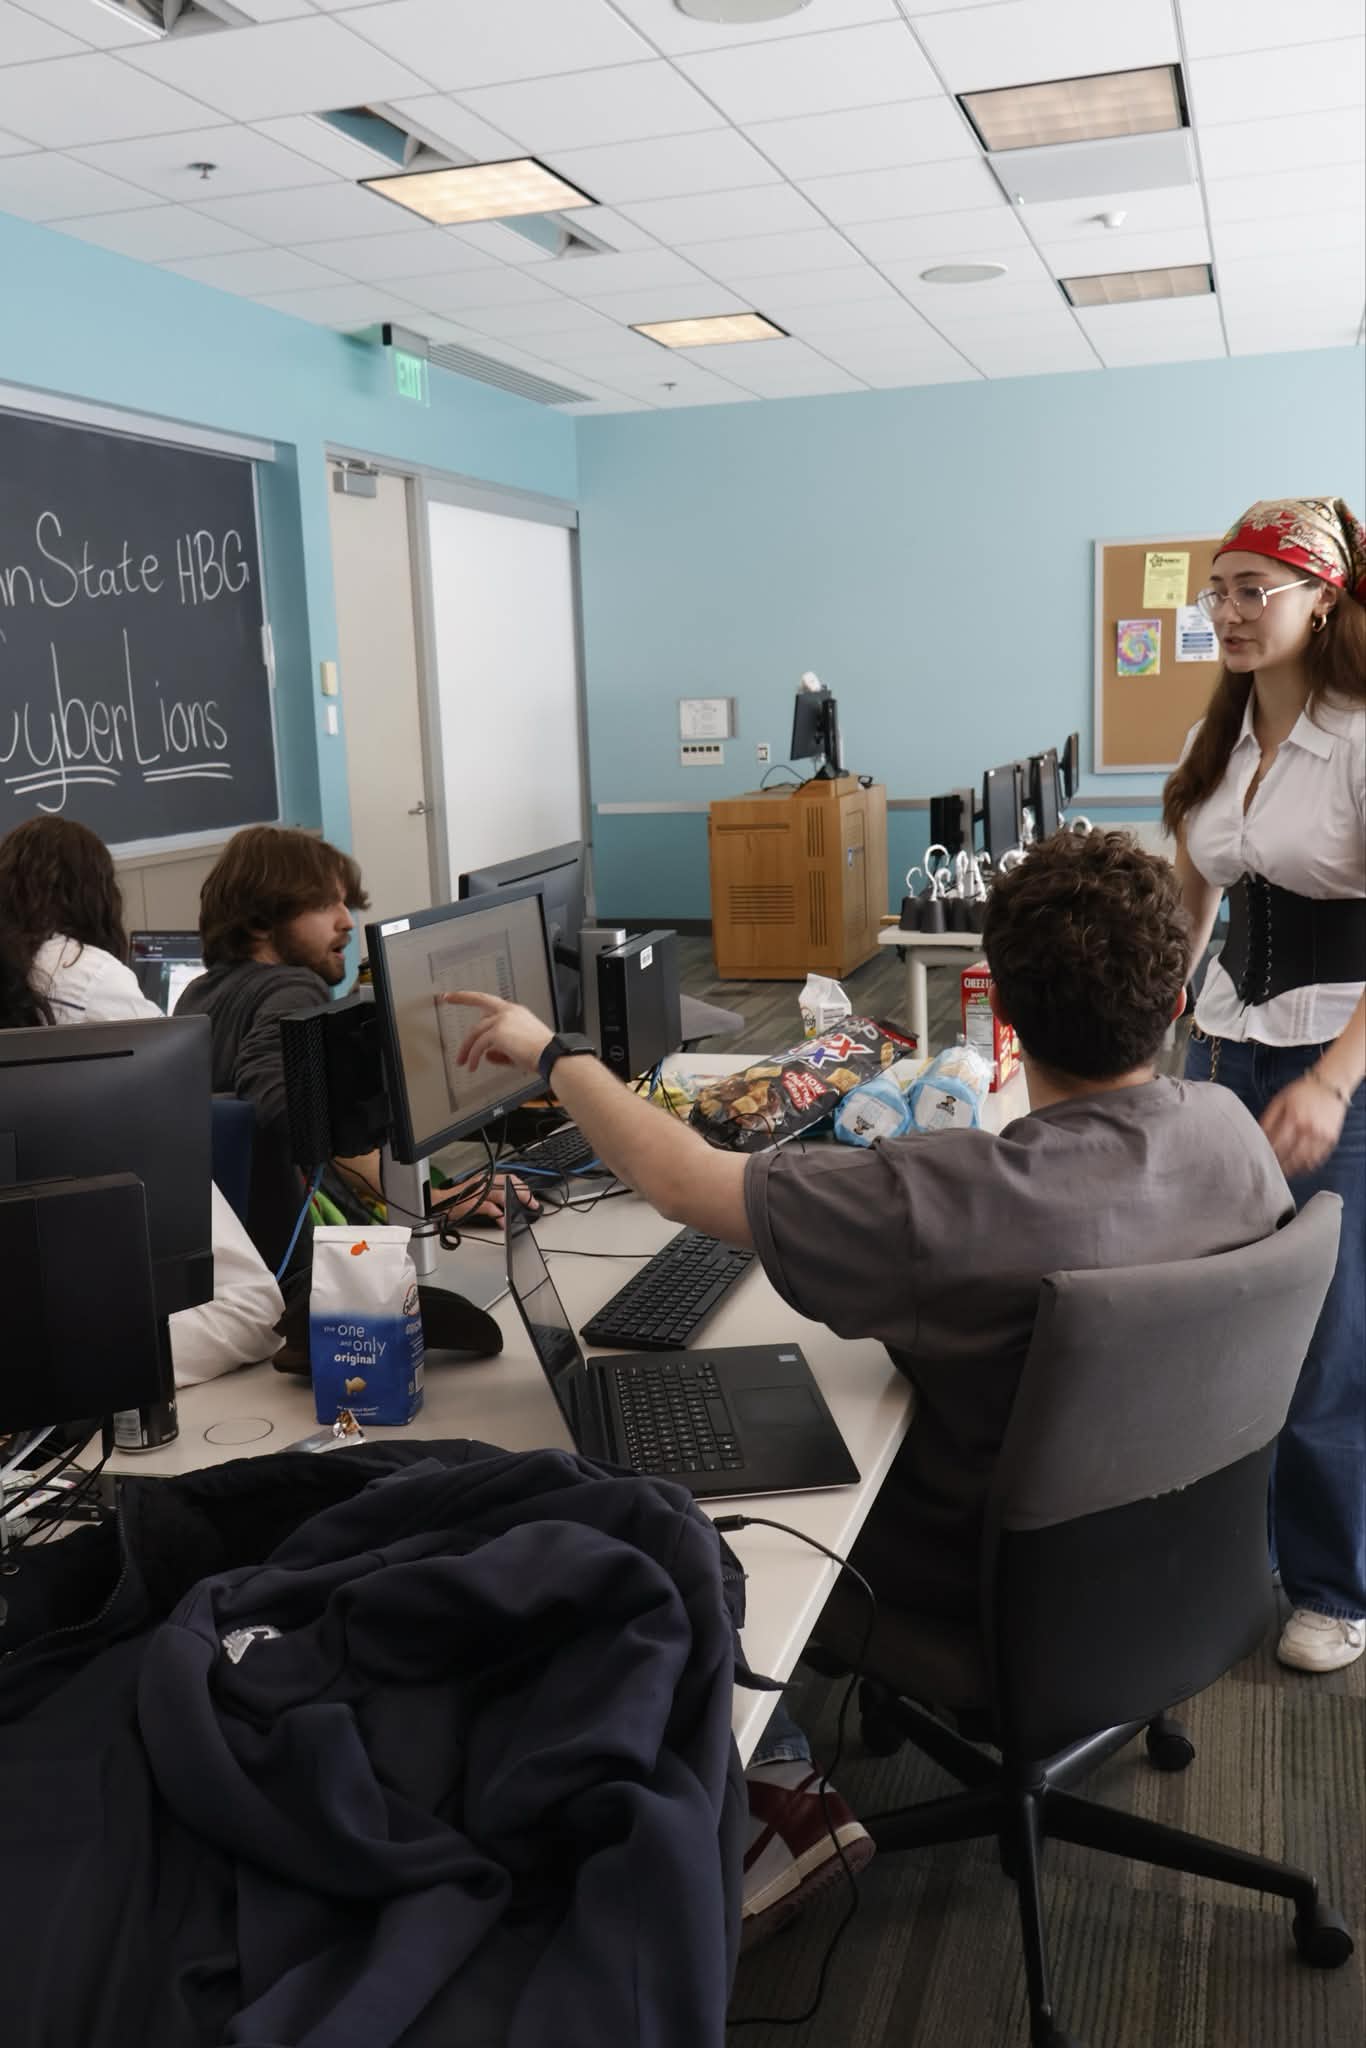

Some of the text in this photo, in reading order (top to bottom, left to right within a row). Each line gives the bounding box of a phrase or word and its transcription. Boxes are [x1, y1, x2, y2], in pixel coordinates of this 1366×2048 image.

[177, 529, 250, 605] HBG
[801, 1071, 827, 1095] NOW
[337, 1324, 365, 1337] one
[352, 1335, 387, 1357] only
[333, 1351, 377, 1366] original
